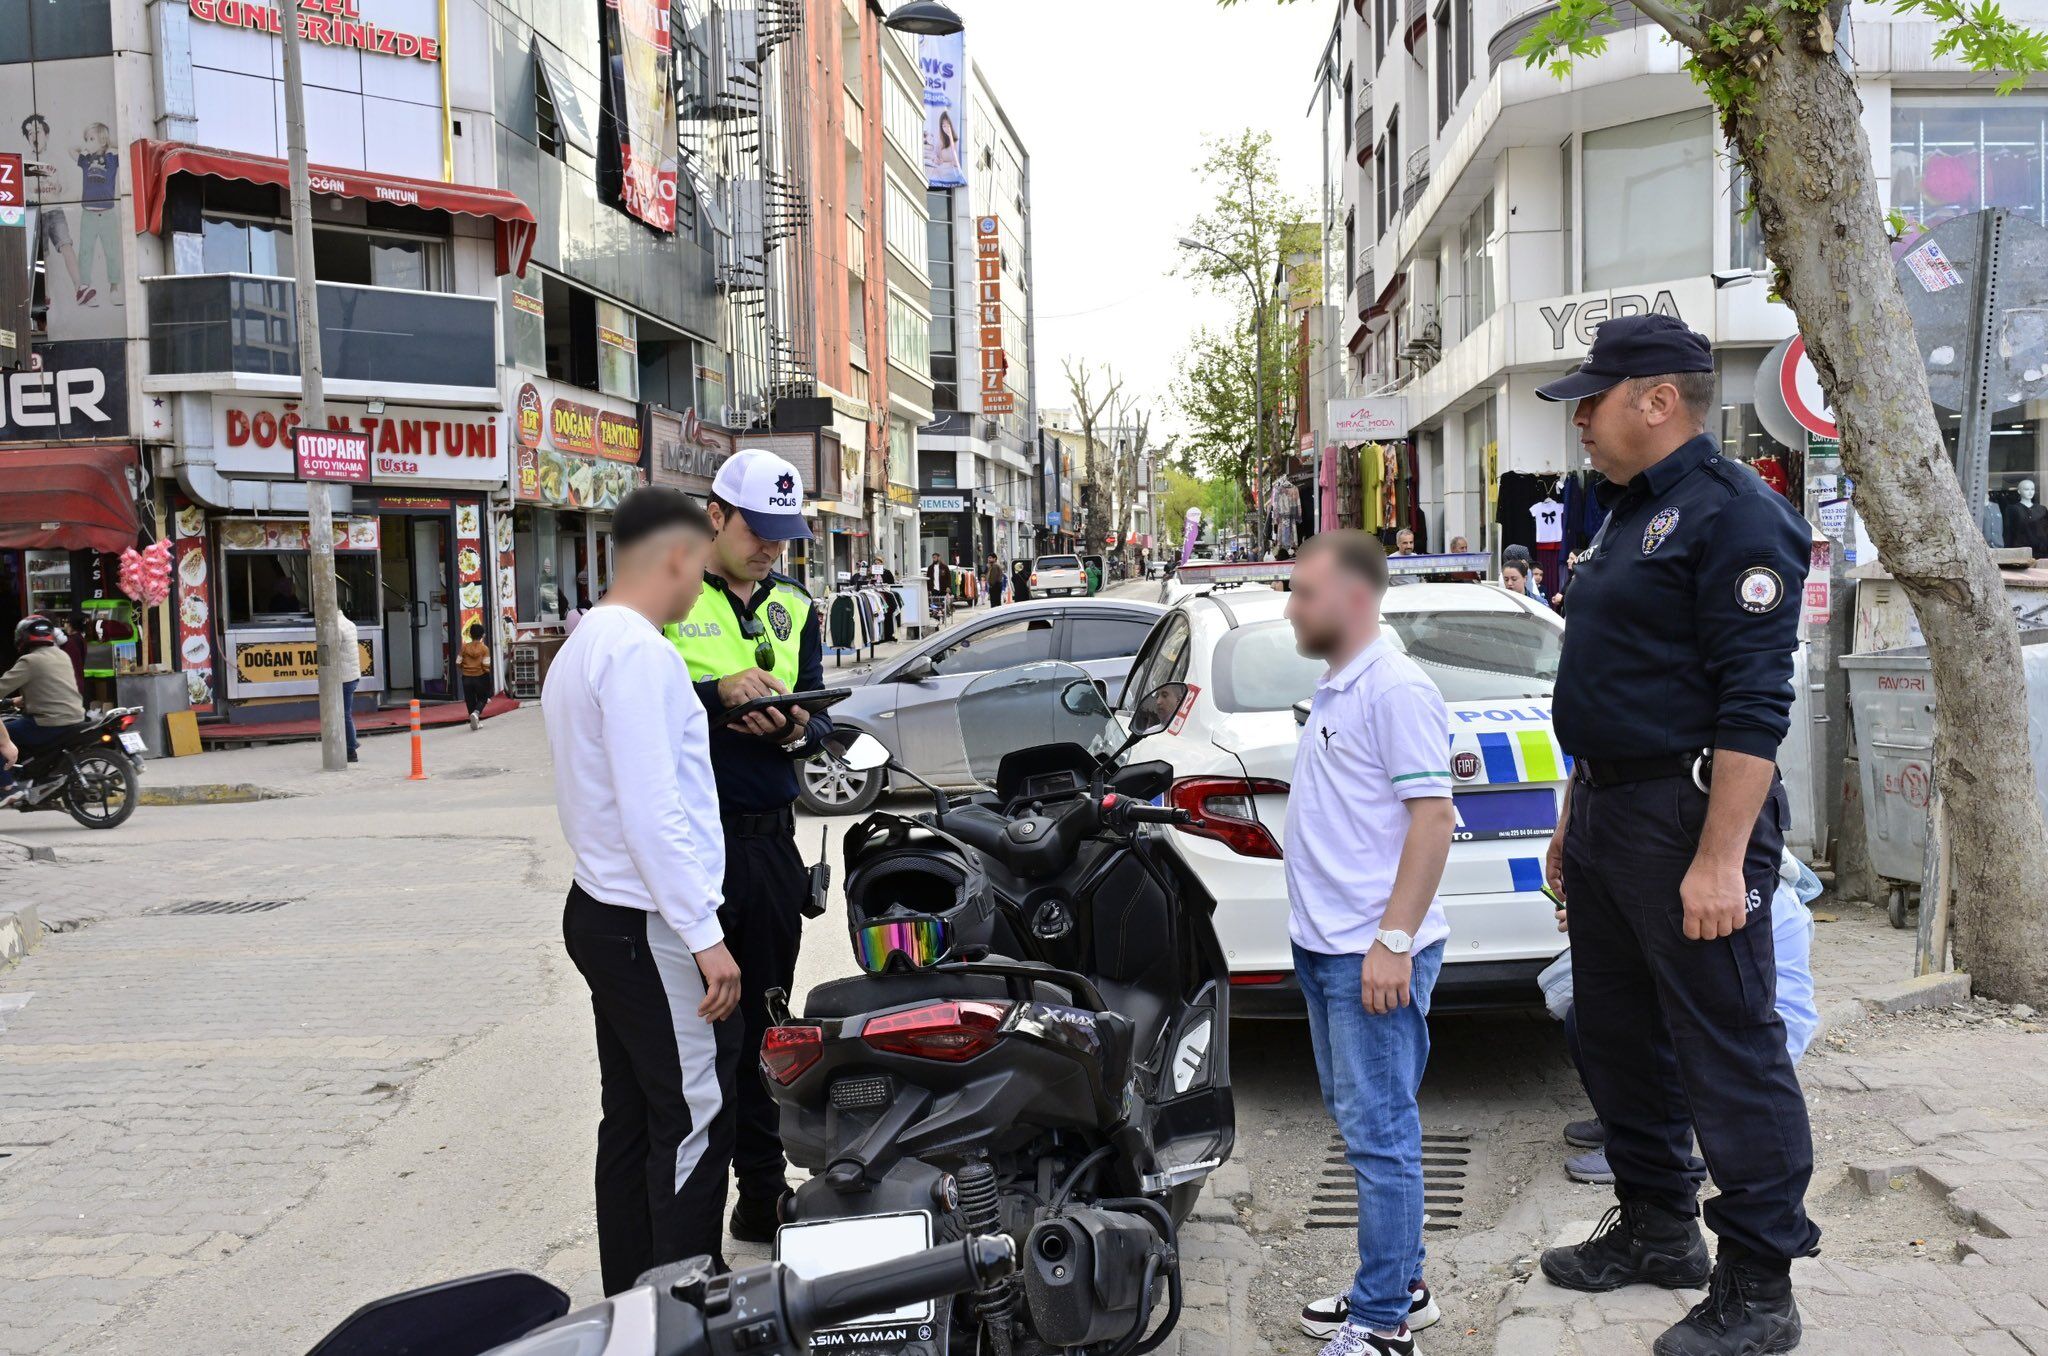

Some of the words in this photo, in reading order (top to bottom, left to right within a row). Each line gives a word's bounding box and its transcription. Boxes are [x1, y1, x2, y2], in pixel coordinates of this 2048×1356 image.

[375, 186, 418, 203] TANTUNİ
[979, 243, 998, 253] VIP
[0, 367, 112, 428] ER
[1368, 419, 1395, 427] MODA
[360, 416, 497, 458] TANTUNİ
[600, 420, 639, 450] TANTUNİ
[298, 435, 367, 460] OTOPARK
[303, 459, 311, 469] &
[311, 460, 331, 470] OTO
[331, 461, 363, 472] YIKAMA
[377, 457, 419, 474] Usta
[1807, 486, 1837, 495] Everest
[244, 649, 293, 668] DOĞAN
[302, 668, 319, 676] Ust
[1878, 676, 1926, 691] FAVORİ
[1454, 706, 1552, 722] POLİ
[1457, 759, 1475, 773] FIAT
[849, 1329, 907, 1344] YAMAN
